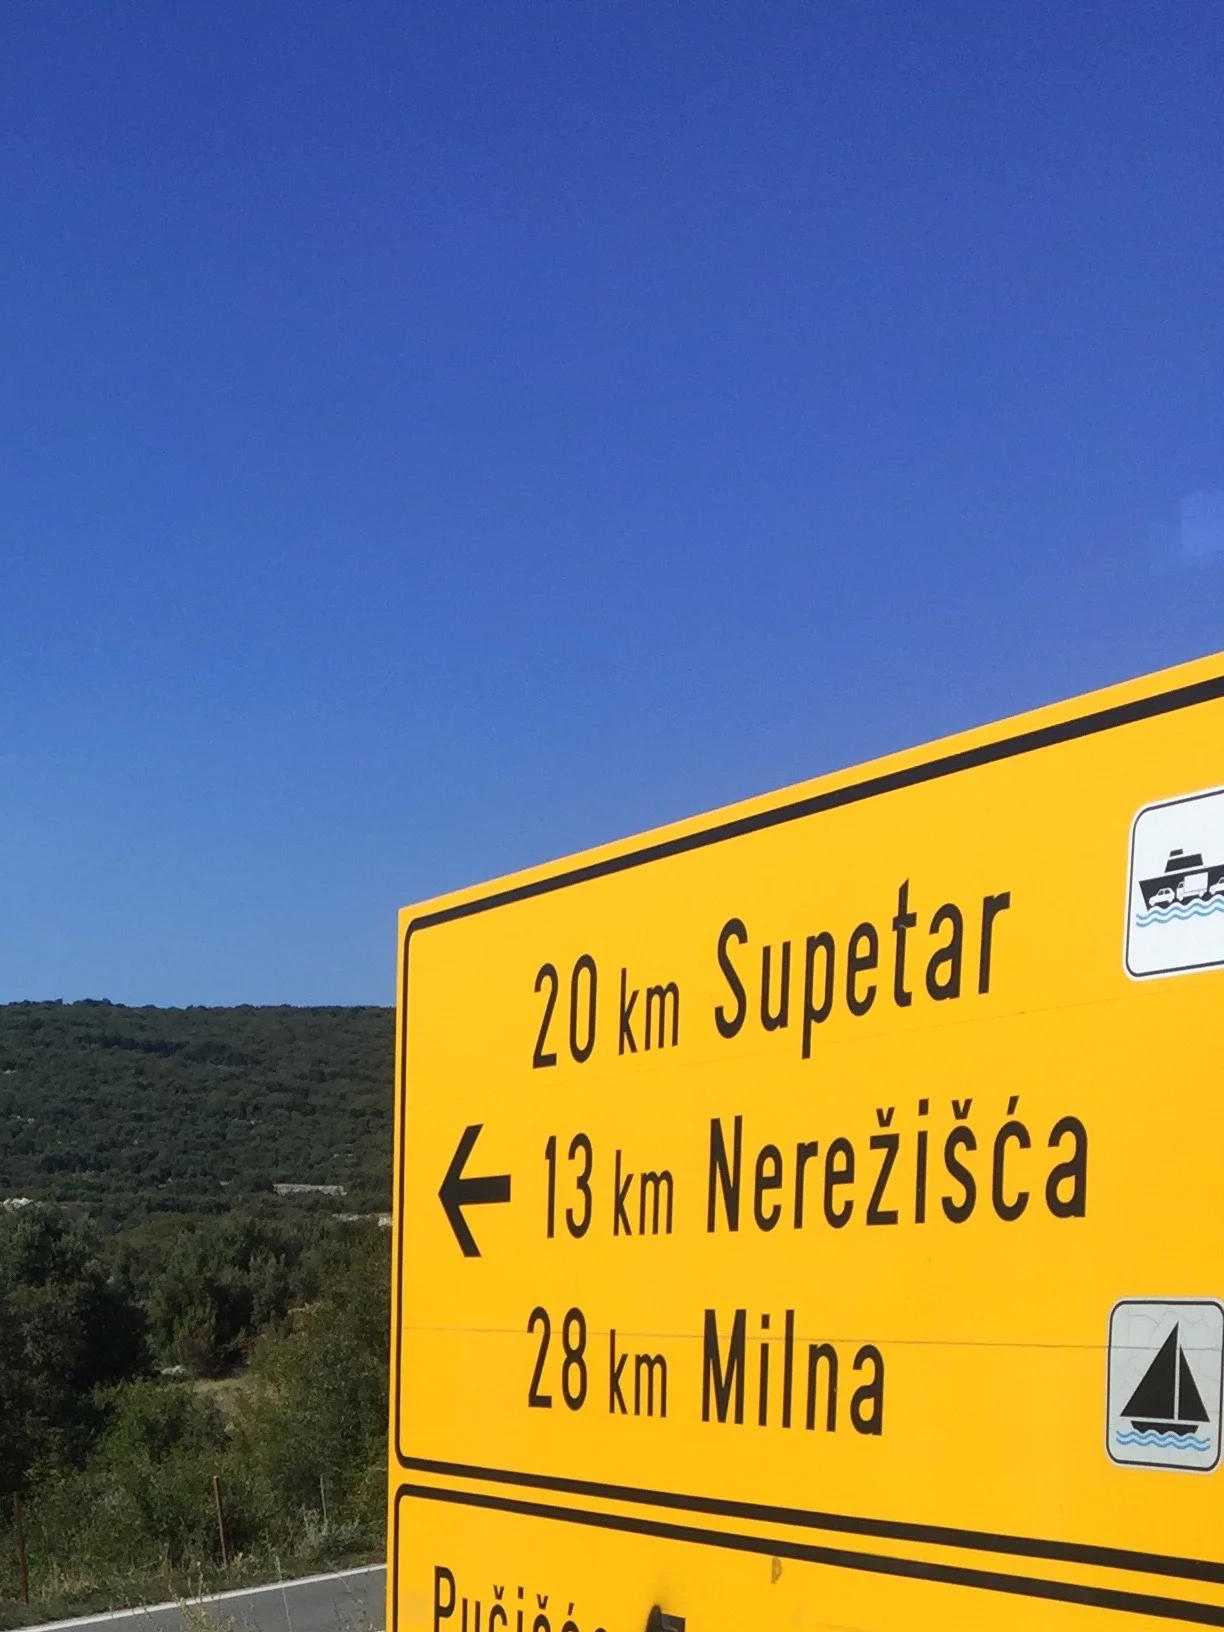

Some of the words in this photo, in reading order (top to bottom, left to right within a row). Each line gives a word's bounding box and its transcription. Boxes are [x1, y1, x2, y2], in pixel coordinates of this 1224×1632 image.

[532, 954, 598, 1069] 20
[618, 967, 680, 1055] km
[714, 879, 1011, 1059] Supetar
[544, 1133, 594, 1239] 13
[613, 1149, 674, 1236] km
[707, 1095, 1089, 1234] Nerežišća
[527, 1306, 587, 1411] 28
[609, 1329, 667, 1419] km
[702, 1309, 885, 1436] Milna
